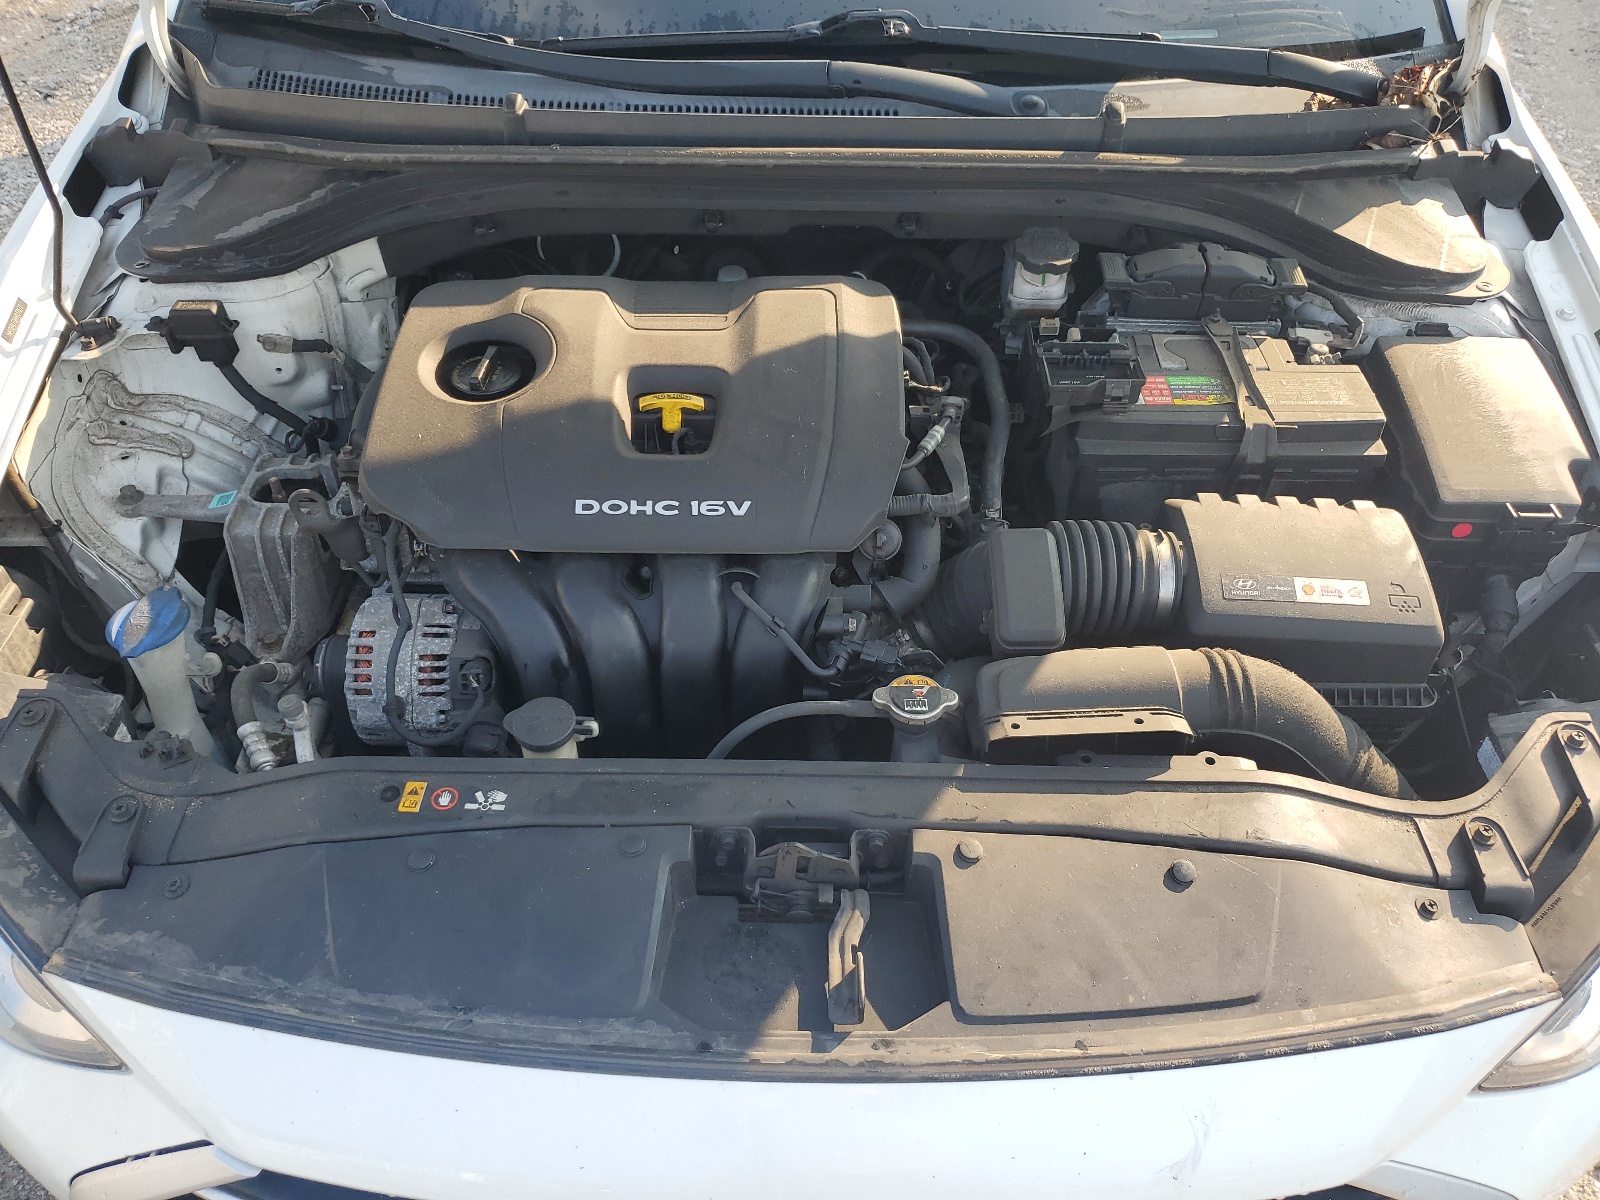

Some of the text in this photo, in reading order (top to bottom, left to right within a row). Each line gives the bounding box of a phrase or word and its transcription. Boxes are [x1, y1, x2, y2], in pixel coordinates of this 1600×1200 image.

[575, 499, 752, 516] DOHC 16V
[1231, 589, 1261, 597] HYUNDAI
